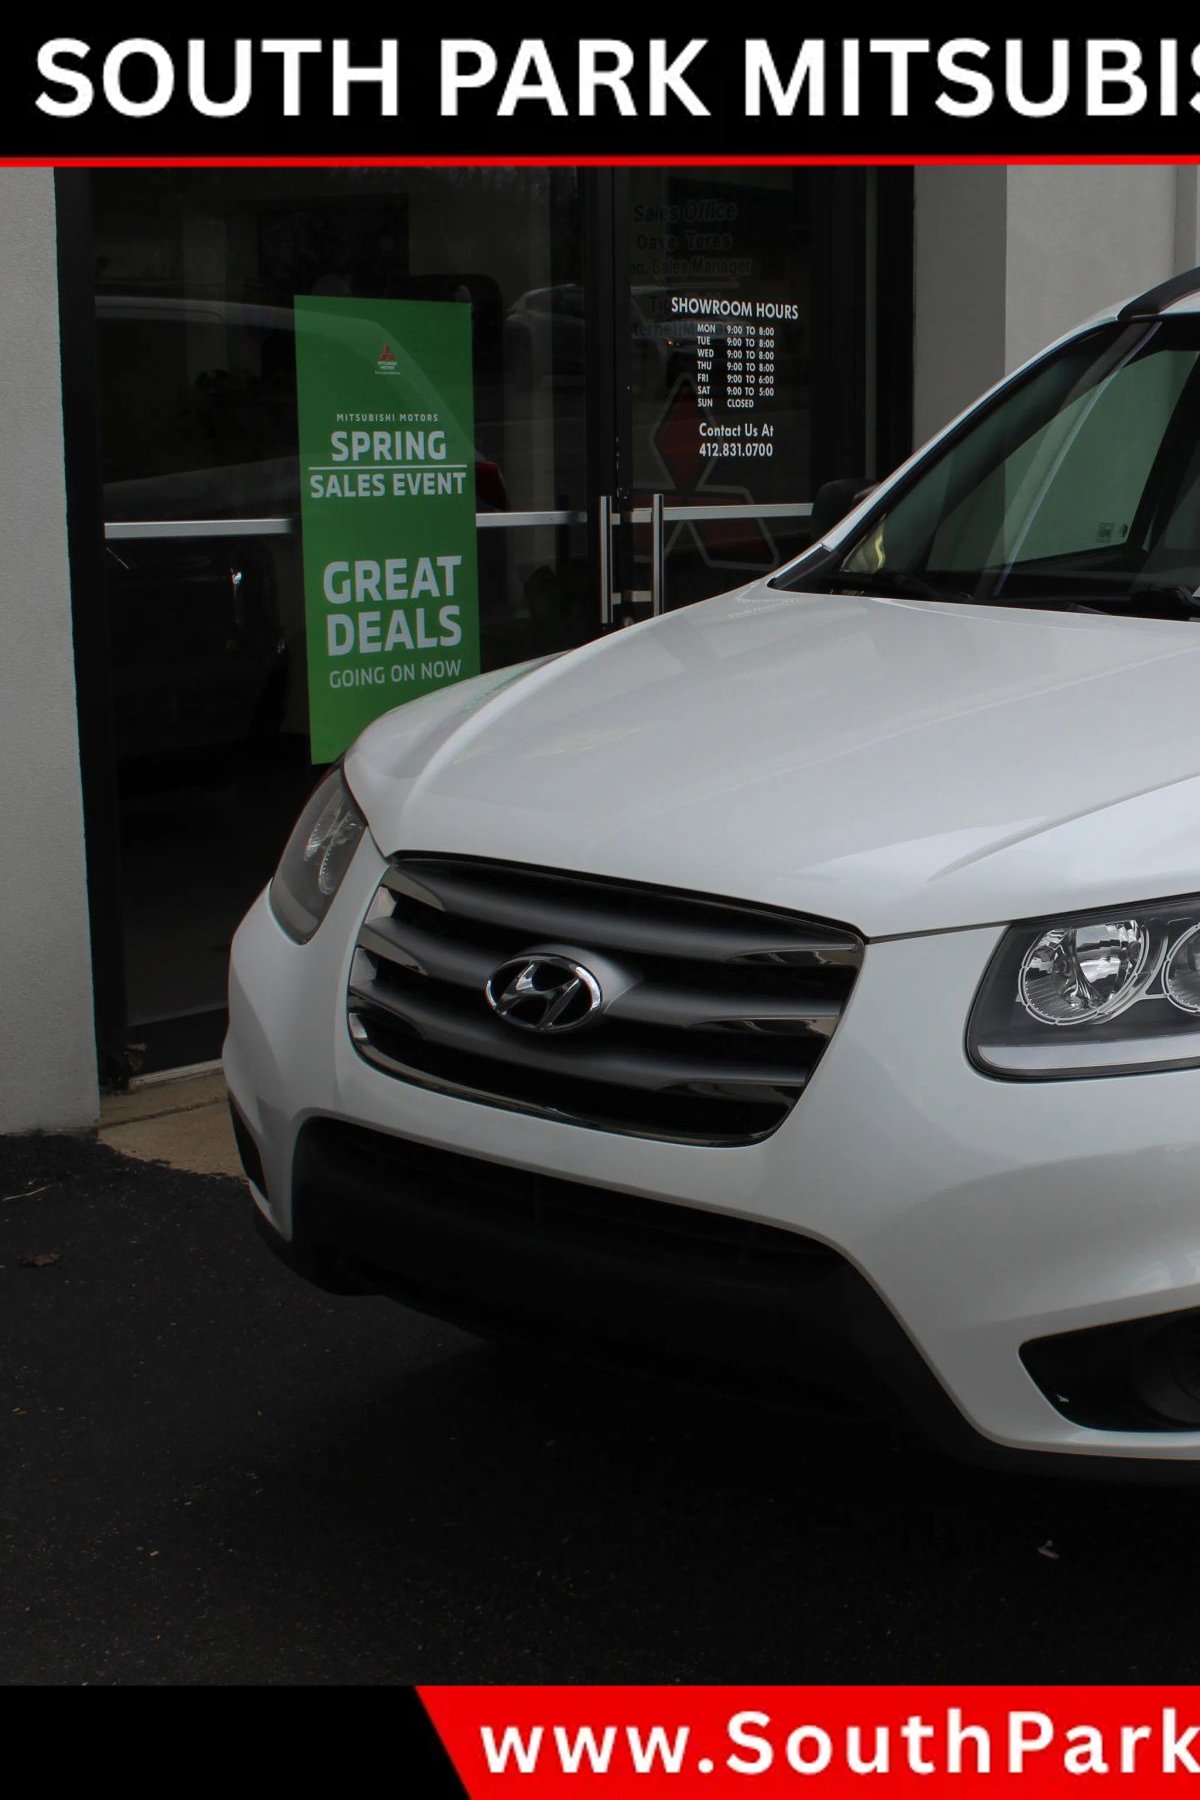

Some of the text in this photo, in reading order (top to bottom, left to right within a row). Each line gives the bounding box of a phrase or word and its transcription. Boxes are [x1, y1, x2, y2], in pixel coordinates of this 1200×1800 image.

[671, 296, 753, 317] SHOWROOM
[756, 302, 799, 320] HOURS
[696, 323, 716, 333] MON
[726, 324, 743, 335] 9:00
[745, 325, 756, 336] TO
[758, 326, 775, 337] 8:00
[696, 335, 775, 349] TUE 9:00 TO 8:00
[696, 348, 775, 361] WED 9:00 TO 8:00
[696, 360, 775, 373] THU 9:00 TO 8:00
[697, 372, 775, 385] FRI 9:00 TO 6:00
[697, 385, 775, 397] SAT 9:00 TO 5:00
[697, 397, 754, 408] SUN CLOSED
[336, 413, 439, 422] MITSUBISHI MOTORS
[698, 422, 774, 437] Contact Us At
[330, 430, 447, 462] SPRING
[698, 442, 774, 457] 412.831.0700
[309, 471, 467, 498] SALES EVENT
[323, 555, 462, 605] GREAT
[326, 605, 462, 657] DEALS
[329, 659, 462, 689] GOING ON NOW
